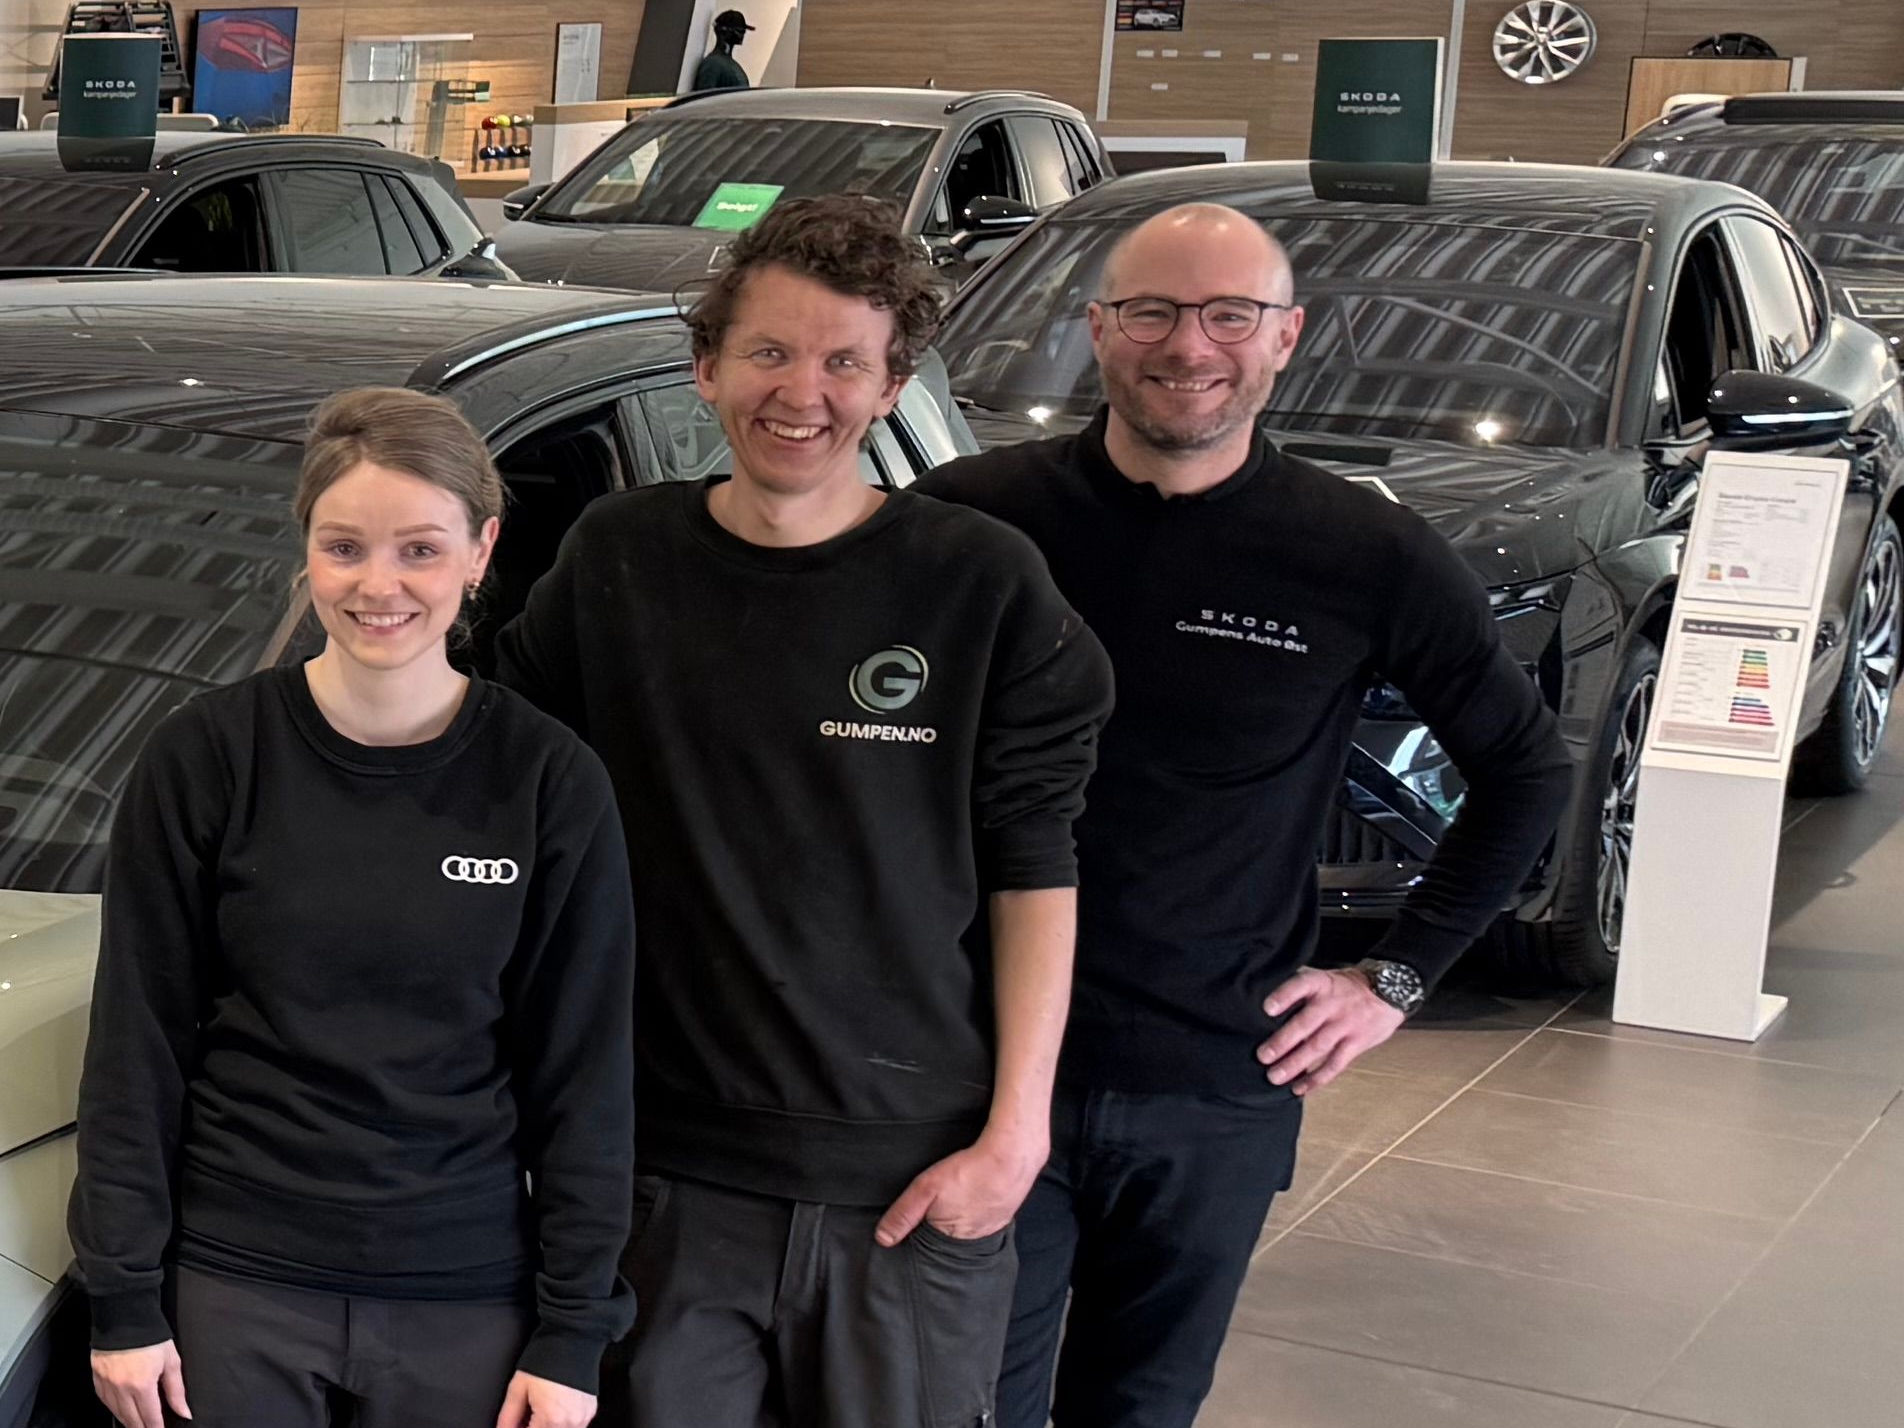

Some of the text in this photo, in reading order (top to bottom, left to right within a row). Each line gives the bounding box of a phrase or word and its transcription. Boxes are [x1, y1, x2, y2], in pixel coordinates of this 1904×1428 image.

[1175, 620, 1244, 640] Gumpens
[1246, 632, 1282, 648] Auto
[1201, 609, 1299, 636] SKODA
[819, 720, 937, 743] GUMPEN.NO
